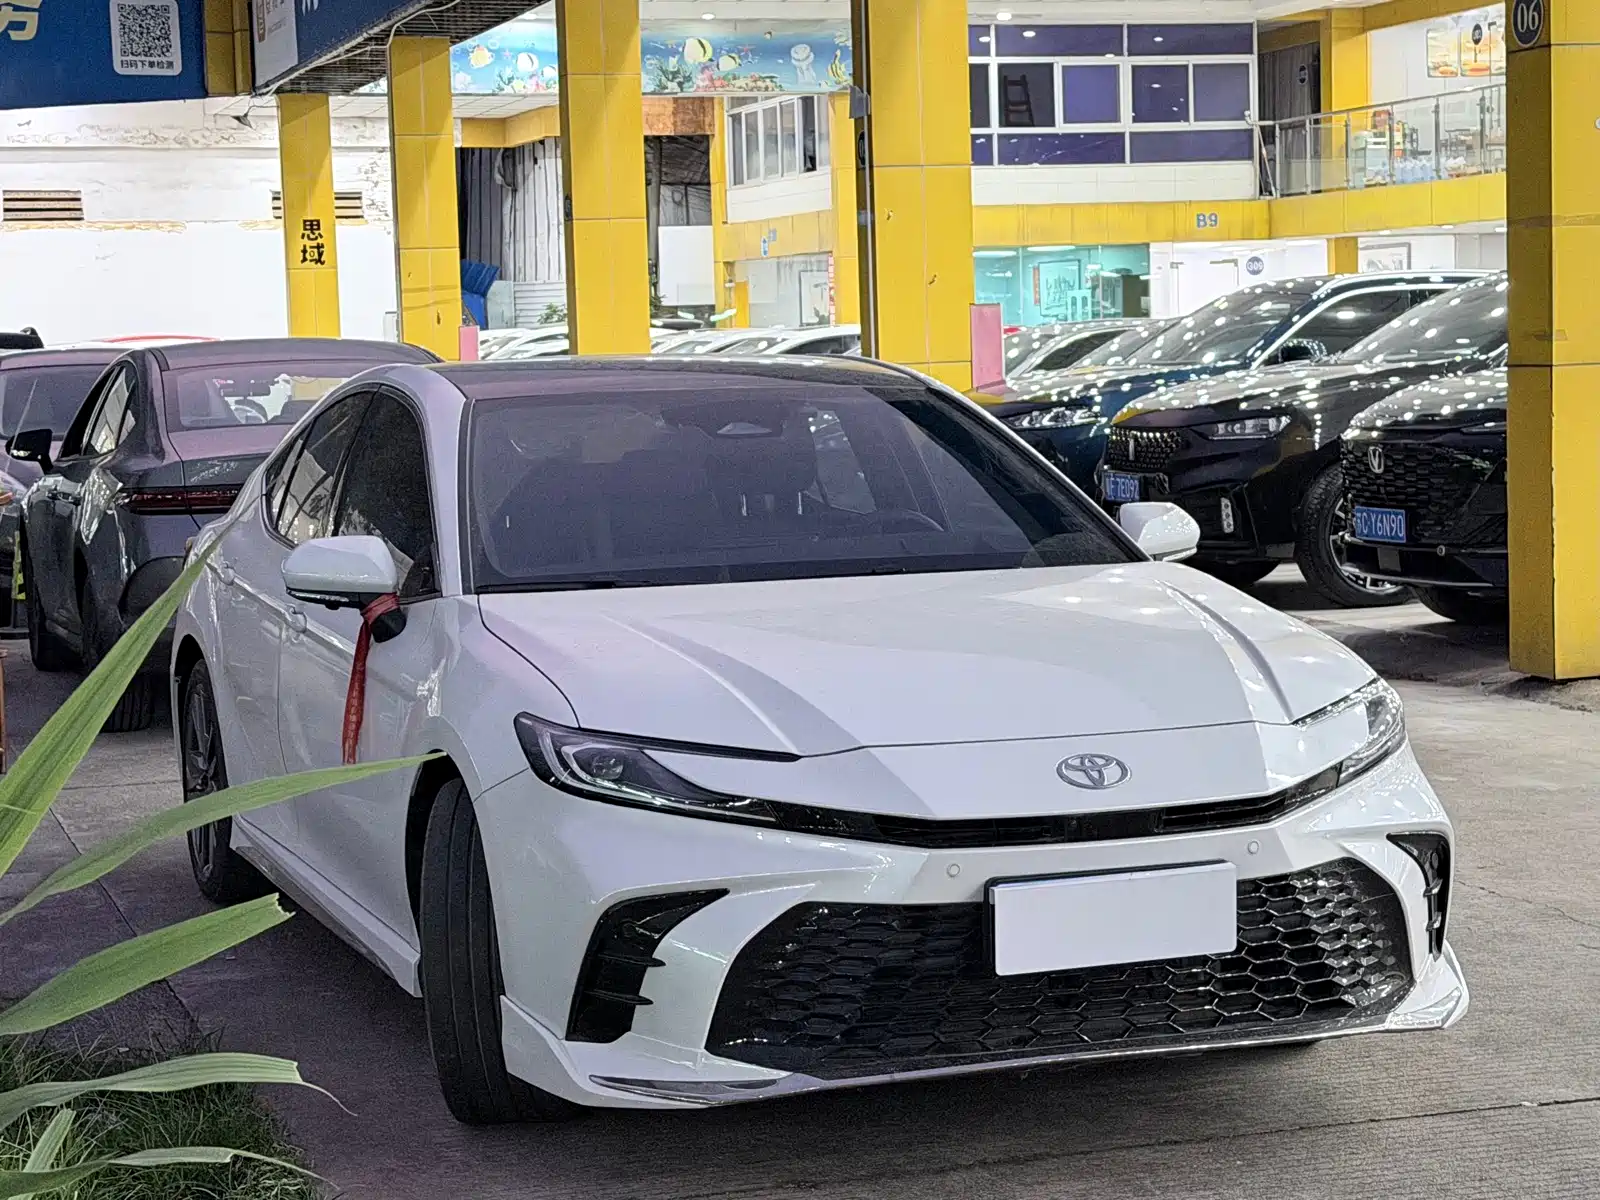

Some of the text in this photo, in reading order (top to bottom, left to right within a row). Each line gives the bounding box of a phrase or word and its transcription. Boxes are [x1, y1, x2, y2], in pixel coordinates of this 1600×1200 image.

[1517, 3, 1539, 33] 06
[120, 60, 174, 70] 扫码下单检测
[1197, 213, 1218, 228] B9
[300, 218, 325, 265] 思域
